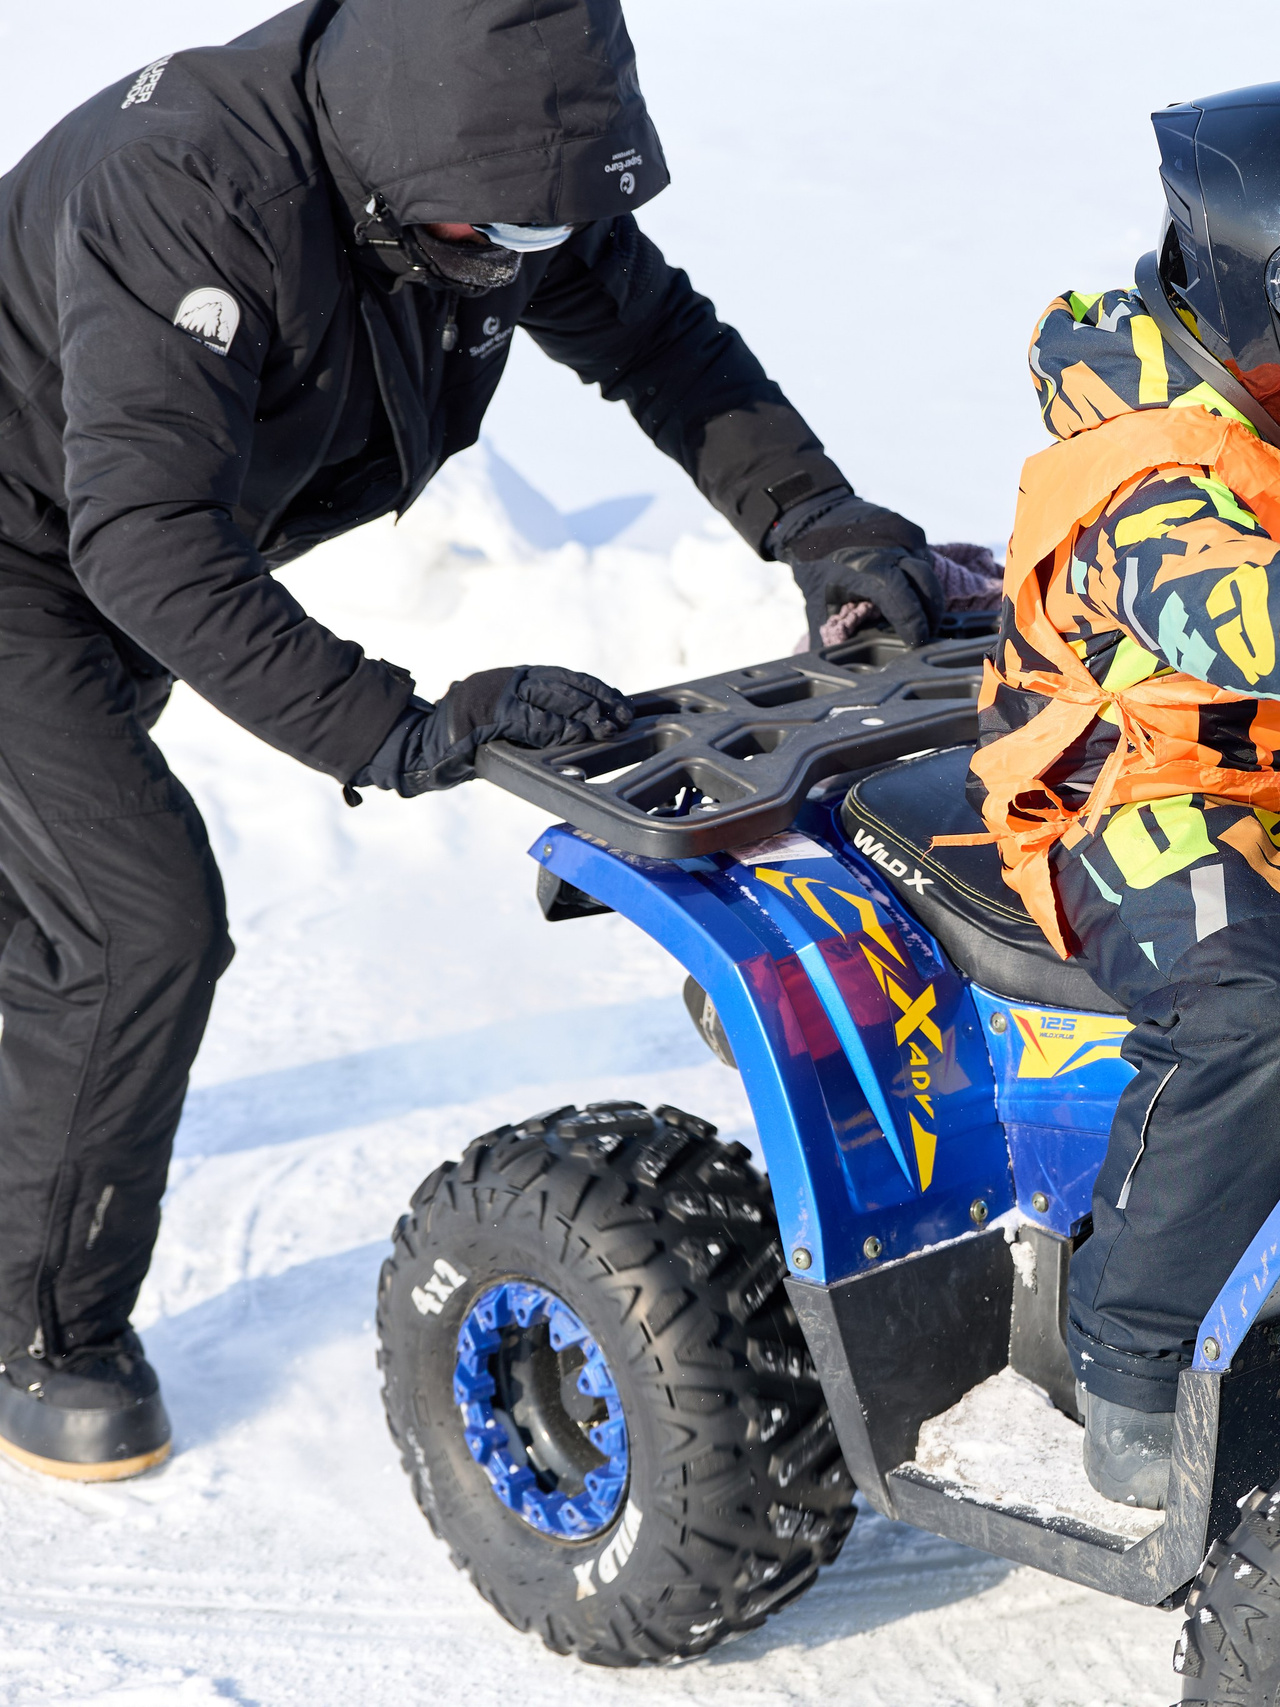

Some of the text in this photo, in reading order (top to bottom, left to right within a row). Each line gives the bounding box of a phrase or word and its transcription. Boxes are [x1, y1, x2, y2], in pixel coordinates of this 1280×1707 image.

[853, 828, 909, 878] WILD
[902, 868, 935, 896] X
[1040, 1016, 1077, 1031] 125
[907, 1041, 935, 1120] ADV
[411, 1258, 468, 1316] 4x2
[572, 1558, 597, 1601] X
